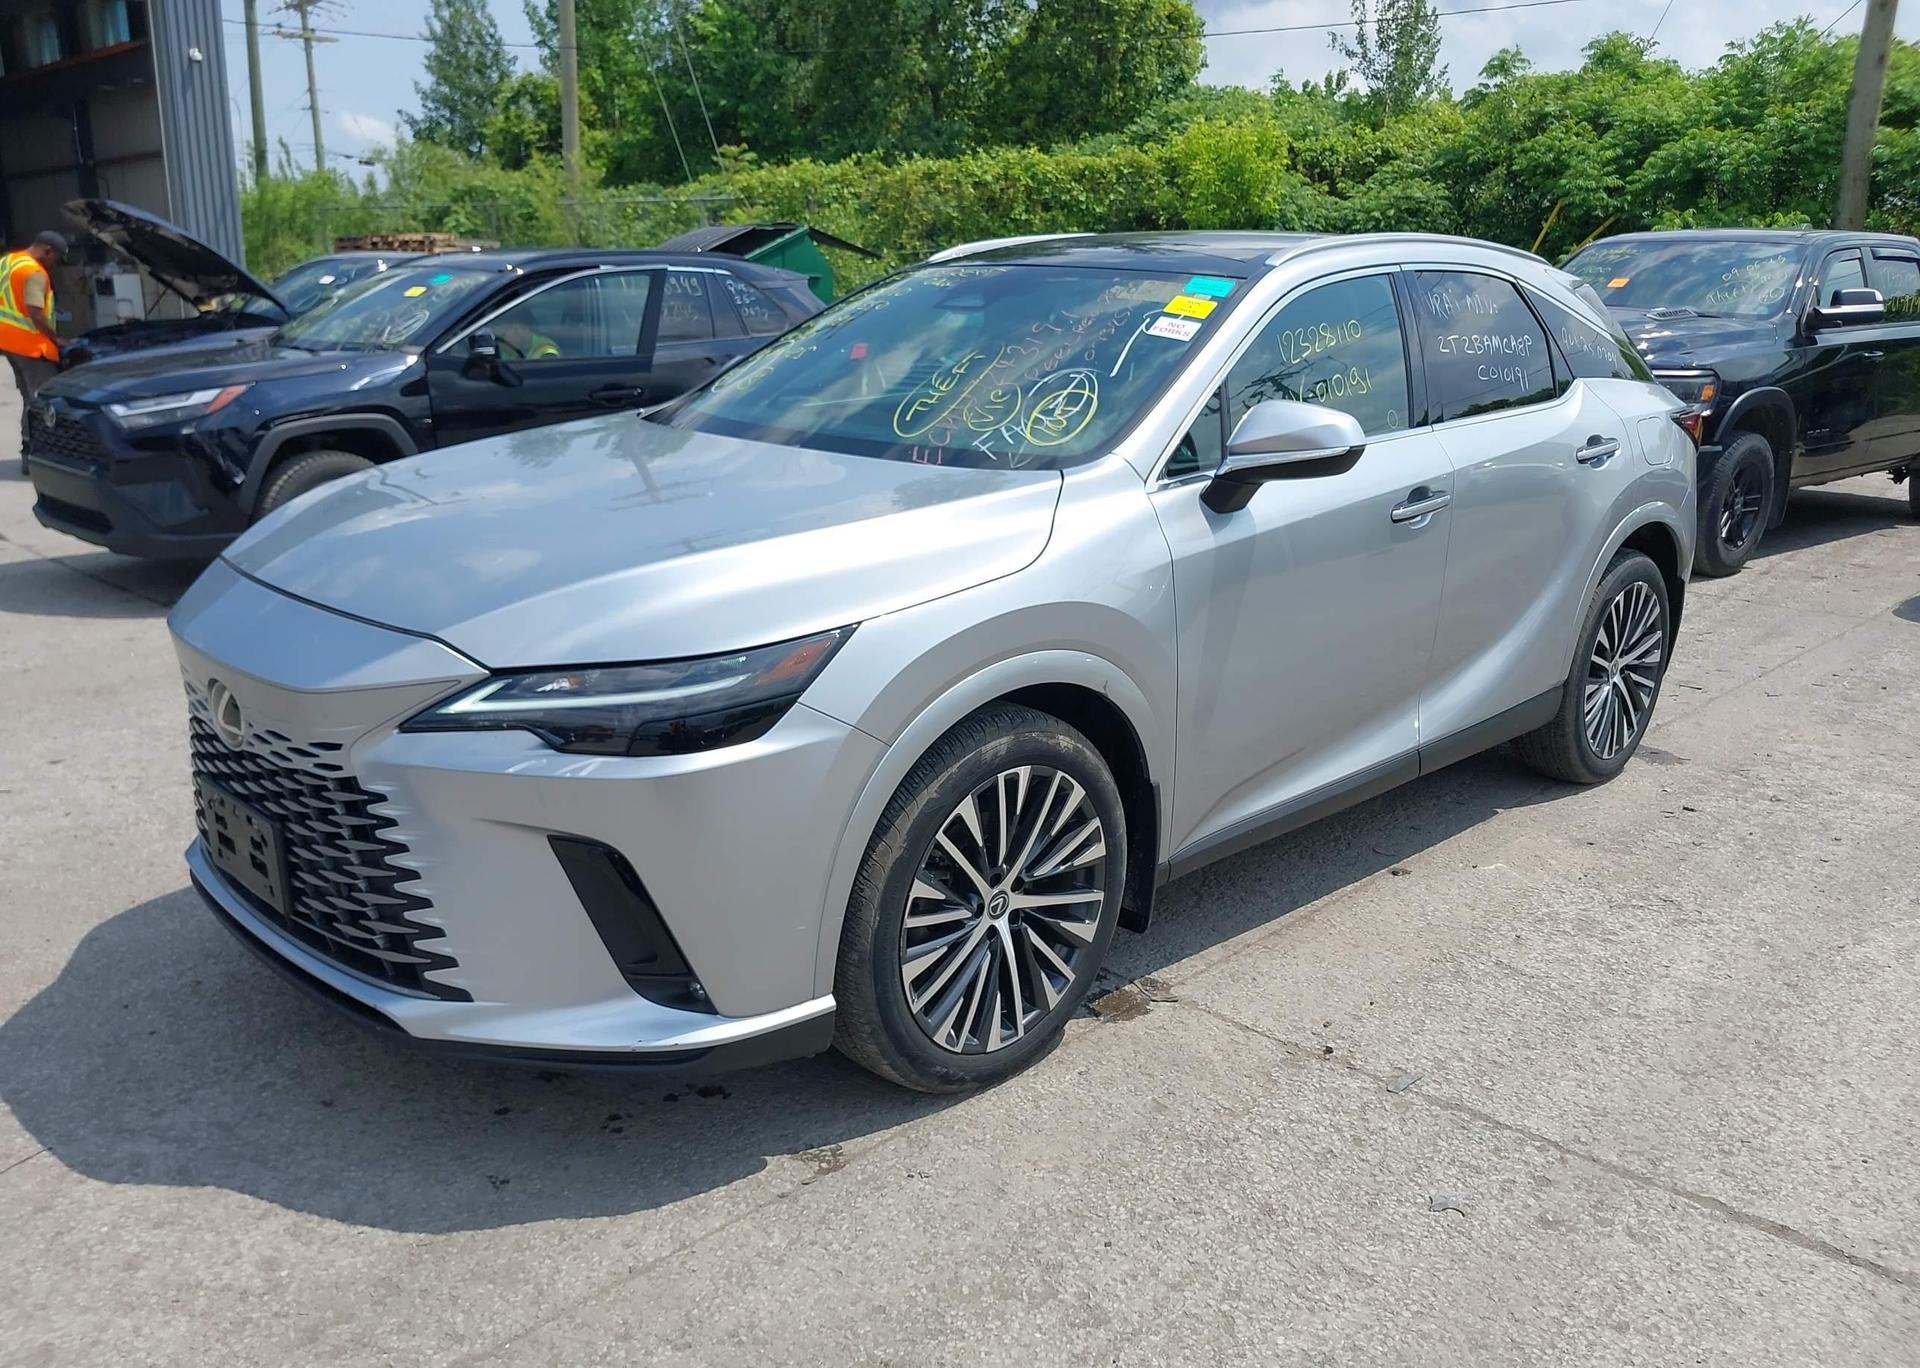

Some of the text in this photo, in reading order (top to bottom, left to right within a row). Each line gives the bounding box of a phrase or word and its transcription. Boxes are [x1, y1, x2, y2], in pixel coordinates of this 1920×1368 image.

[1152, 324, 1192, 338] FORKS
[1167, 321, 1187, 330] NO
[1276, 319, 1363, 365] 12328110
